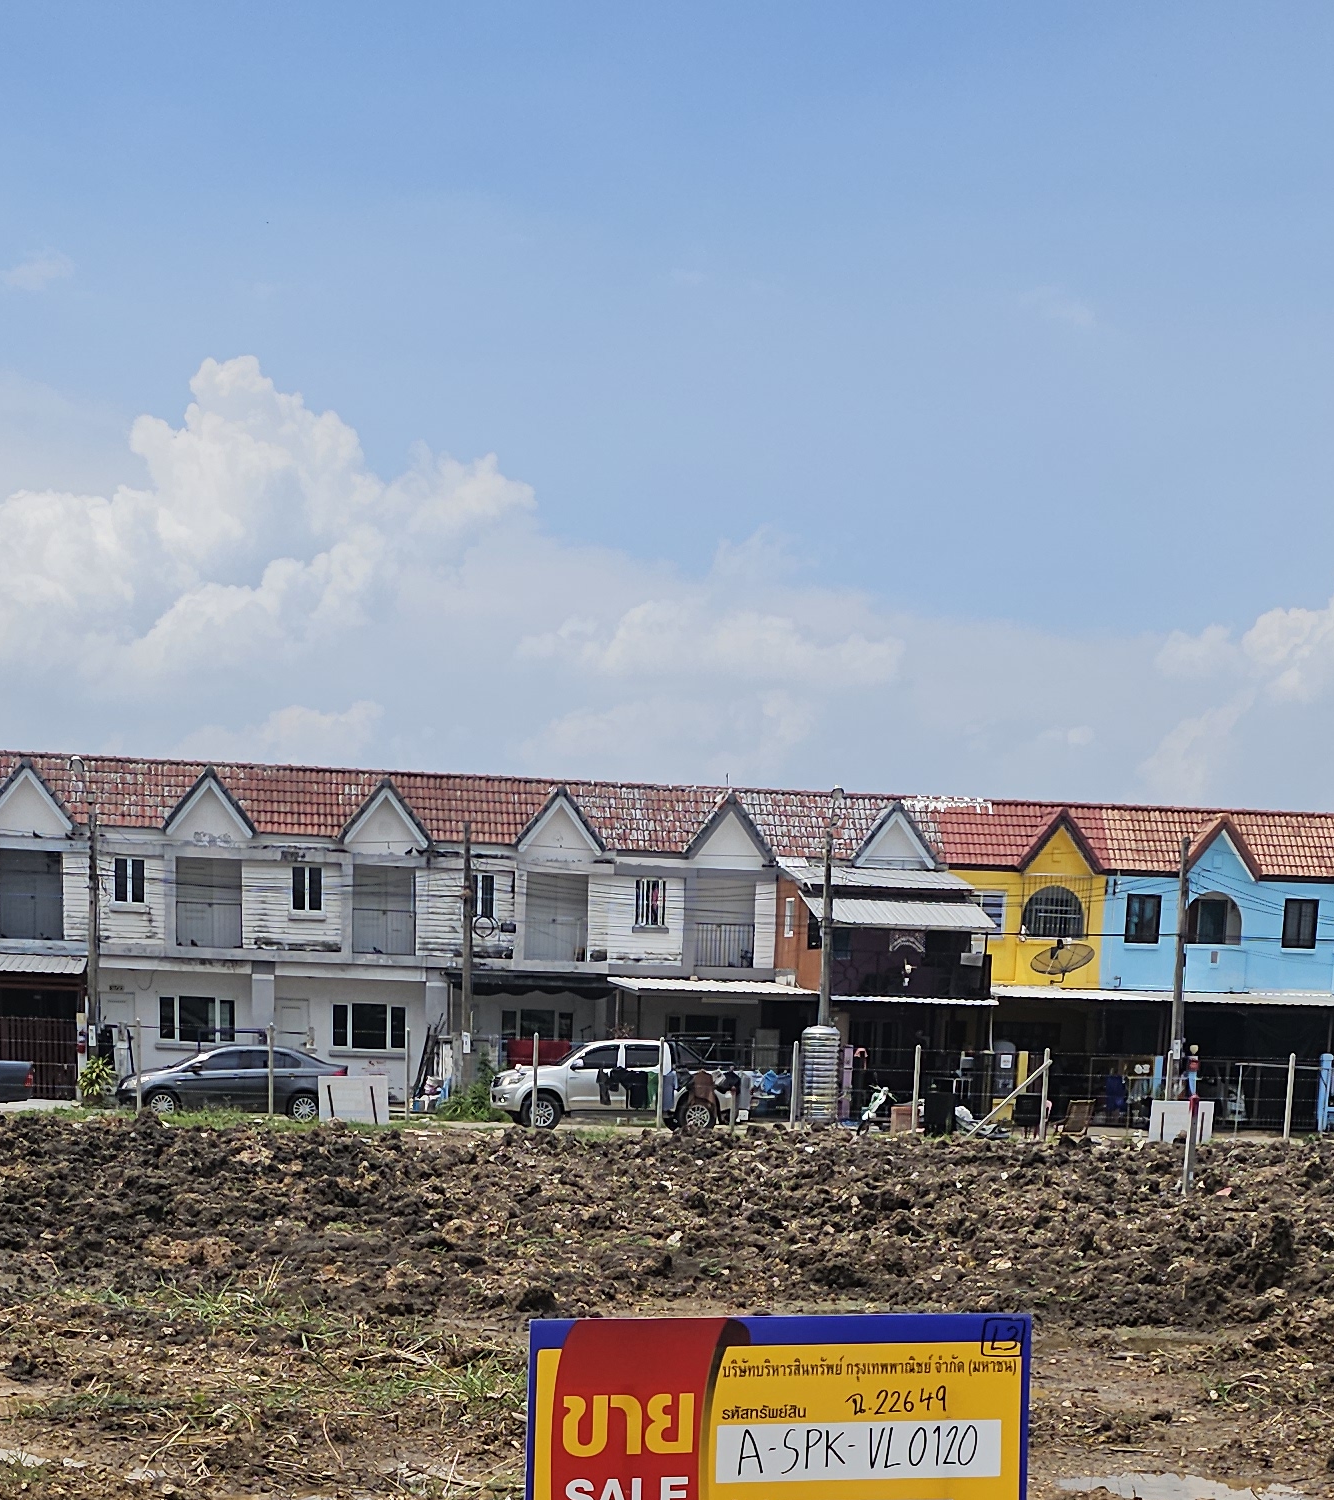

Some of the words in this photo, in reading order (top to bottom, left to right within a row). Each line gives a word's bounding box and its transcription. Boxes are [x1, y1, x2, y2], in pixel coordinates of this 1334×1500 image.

[722, 1355, 845, 1378] บริษัทบริหารสินทรัพย์
[846, 1354, 934, 1382] กรุงเทพพาณิชย์
[934, 1354, 965, 1374] จำกัด
[968, 1359, 1017, 1377] (มหาชน)
[562, 1393, 694, 1457] ขาย
[722, 1404, 807, 1420] รหัสทรัพย์สิน
